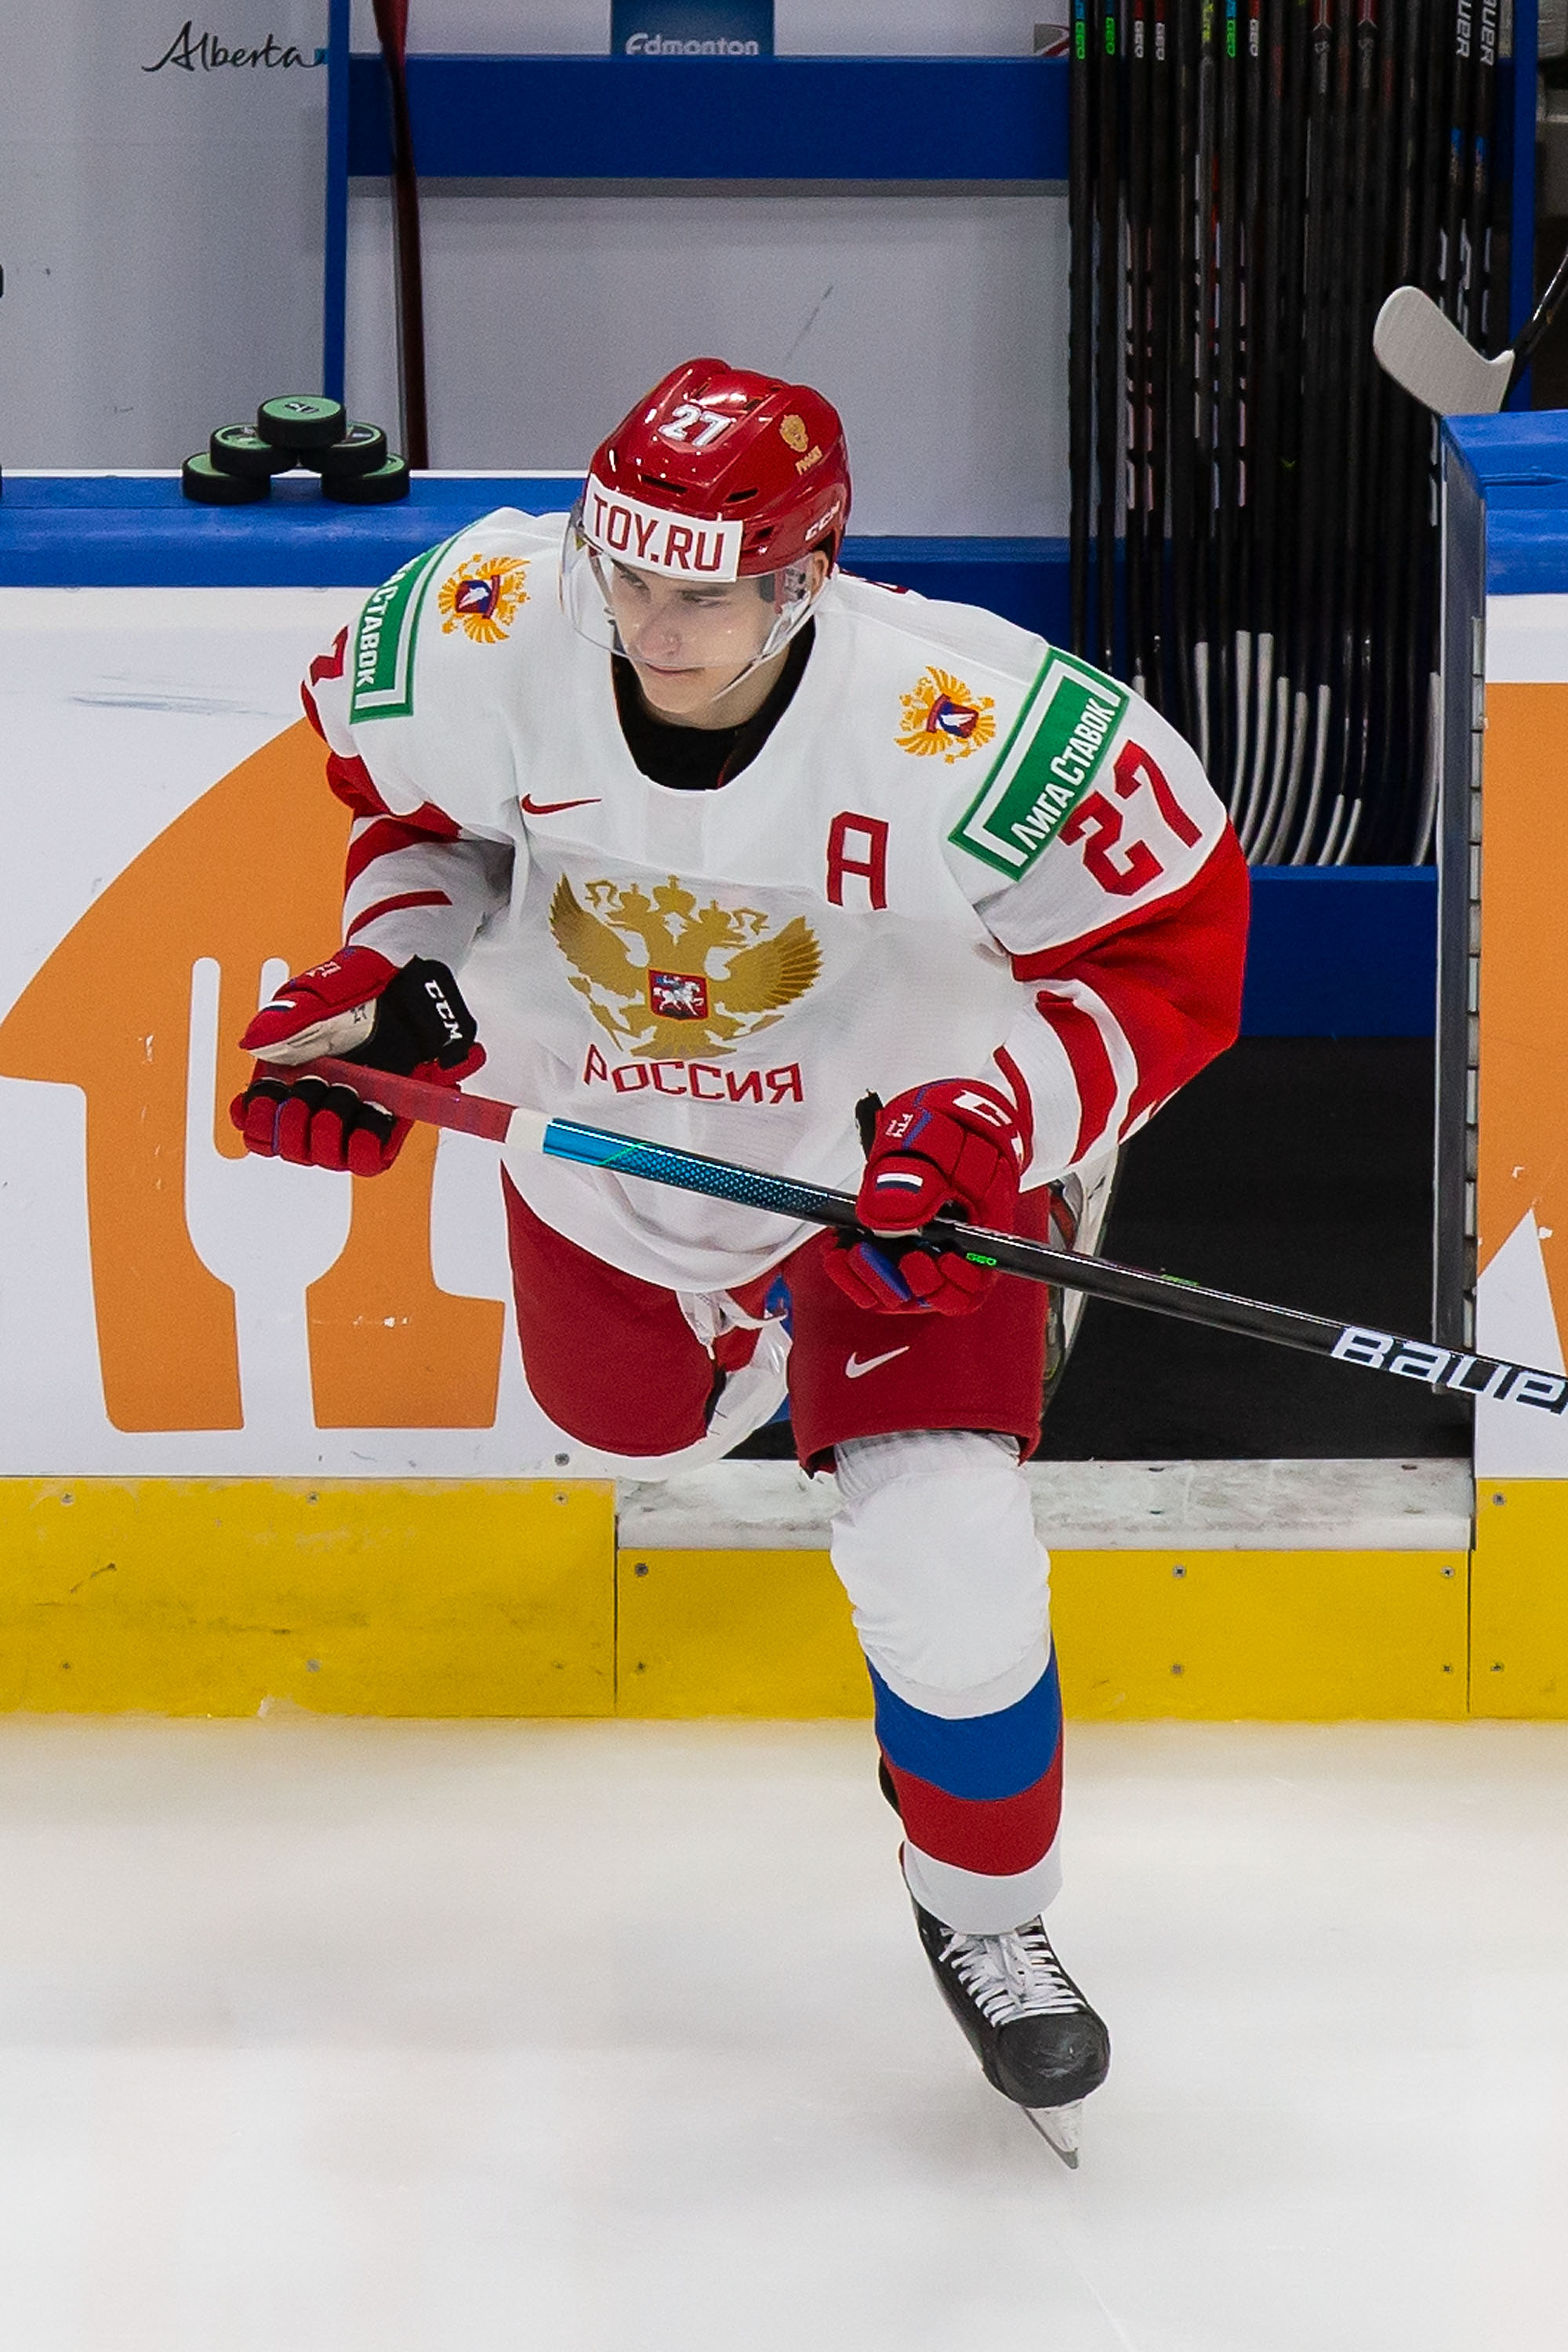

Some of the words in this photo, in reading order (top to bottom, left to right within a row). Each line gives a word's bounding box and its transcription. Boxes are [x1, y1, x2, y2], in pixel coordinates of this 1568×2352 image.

[142, 20, 326, 71] Alberta
[625, 32, 760, 55] Edmonton
[1456, 0, 1472, 58] UER
[658, 404, 731, 448] 27
[593, 494, 725, 572] TOY.RU
[356, 586, 399, 688] СТАВОК
[1058, 739, 1203, 896] 27
[826, 811, 889, 910] A
[424, 979, 463, 1047] CCM
[583, 1043, 804, 1104] РОССИЯ
[1330, 1326, 1568, 1416] BAUE
